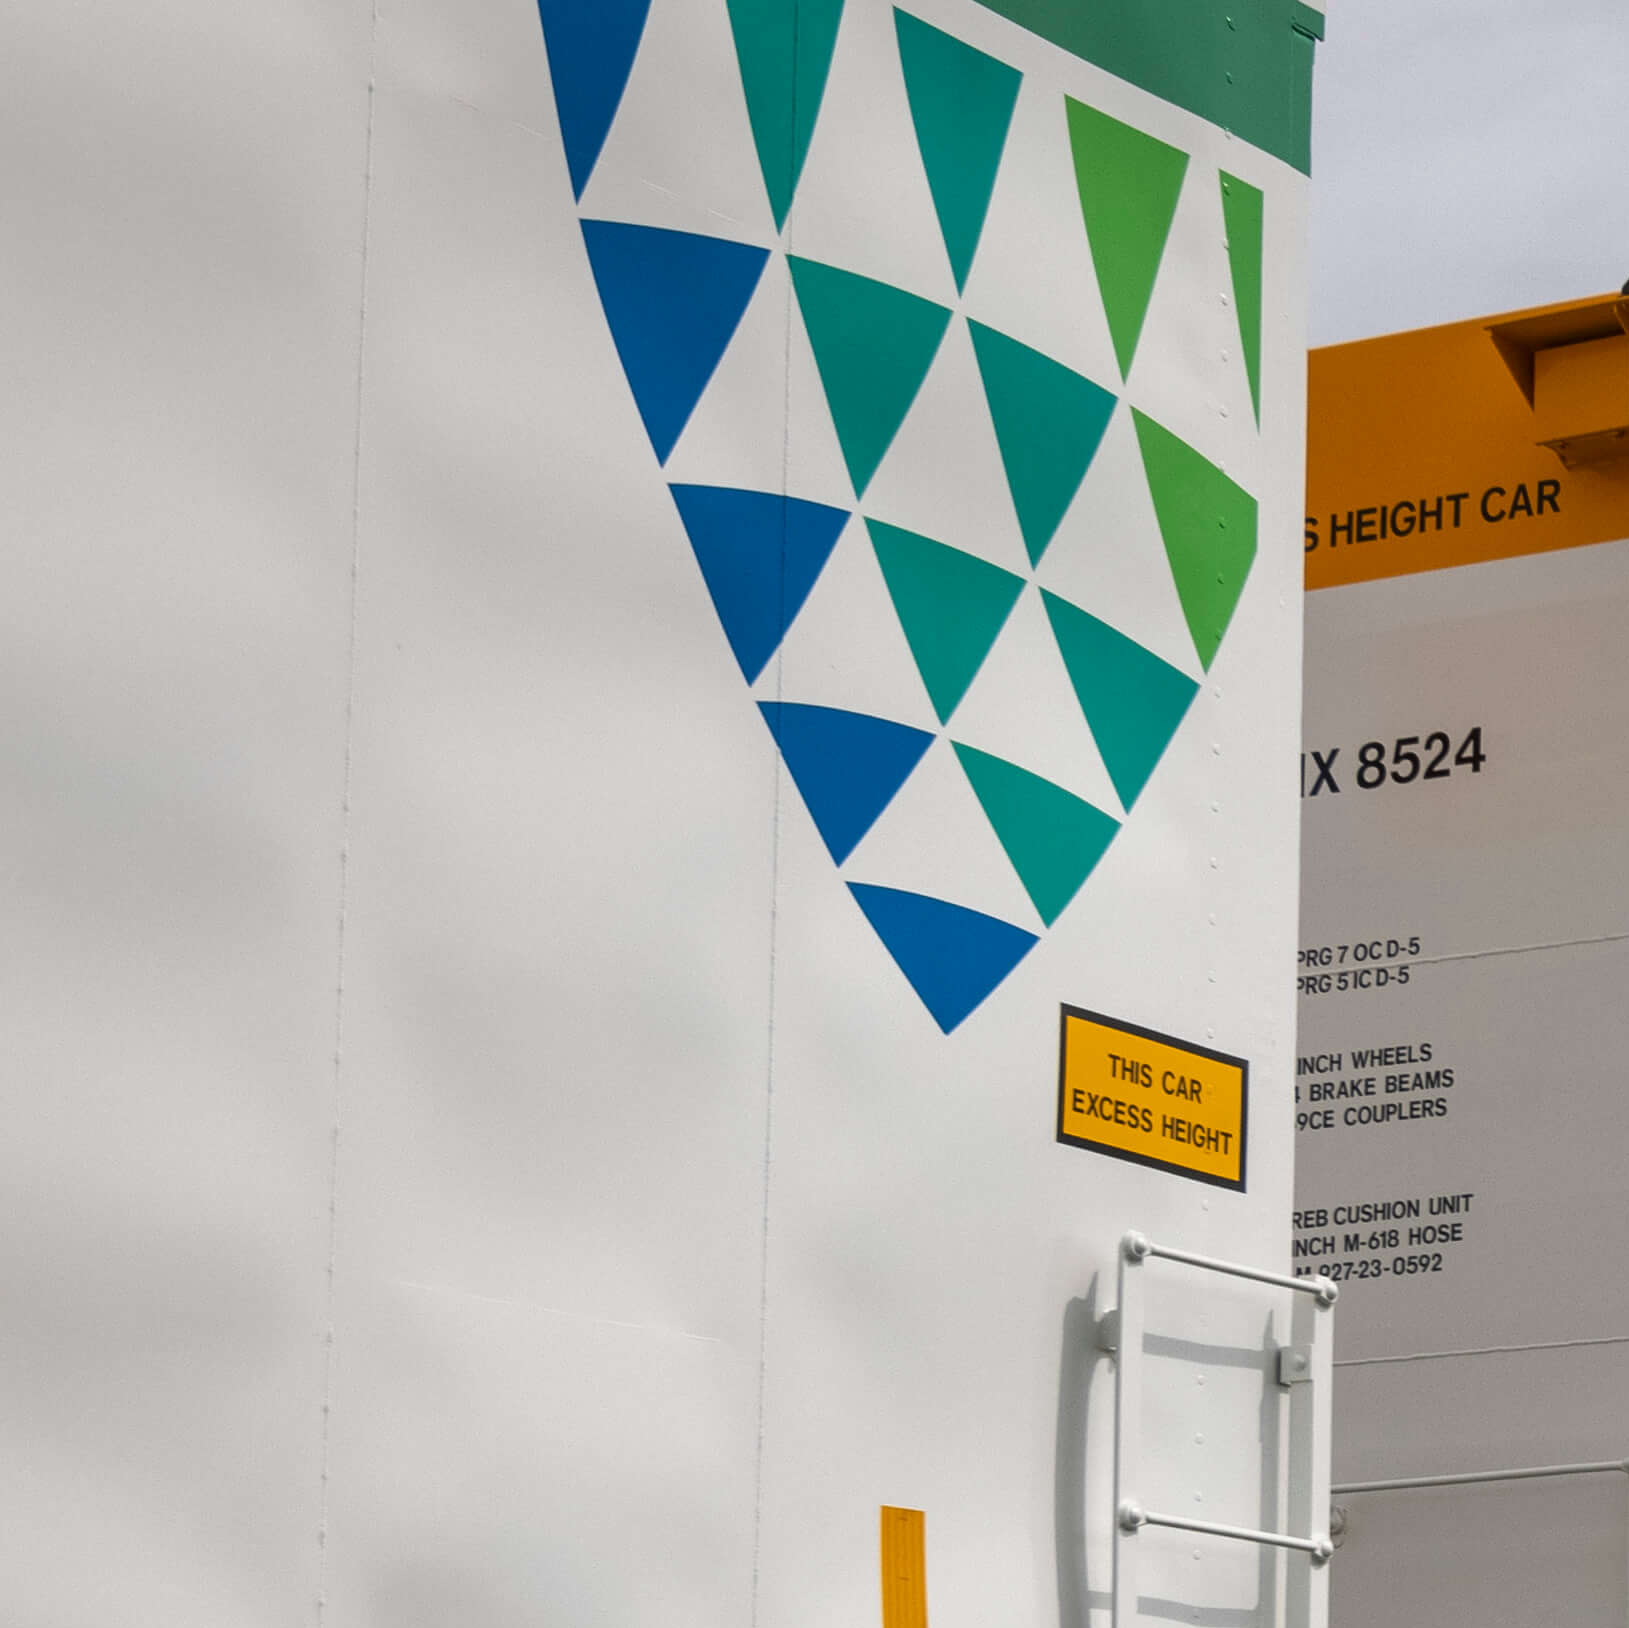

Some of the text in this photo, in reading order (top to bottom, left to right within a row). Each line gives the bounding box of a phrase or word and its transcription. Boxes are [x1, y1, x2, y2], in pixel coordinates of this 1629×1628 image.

[1330, 492, 1468, 547] HEIGHT
[1481, 480, 1561, 523] CAR
[1301, 727, 1486, 798] X 8524
[1337, 945, 1349, 963] 7
[1386, 936, 1421, 957] D-5
[1336, 973, 1349, 991] 5
[1375, 966, 1410, 986] D-5
[1297, 1043, 1433, 1076] INCH WHEELS
[1107, 1053, 1202, 1104] THIS CAR
[1309, 1078, 1377, 1102] BRAKE
[1385, 1068, 1455, 1093] BEAMS
[1072, 1088, 1233, 1155] EXCESS HEIGHT
[1344, 1098, 1448, 1126] COUPLERS
[1334, 1199, 1420, 1225] CUSHION
[1428, 1193, 1474, 1216] UNIT
[1344, 1229, 1400, 1252] M-618
[1408, 1222, 1463, 1246] HOSE
